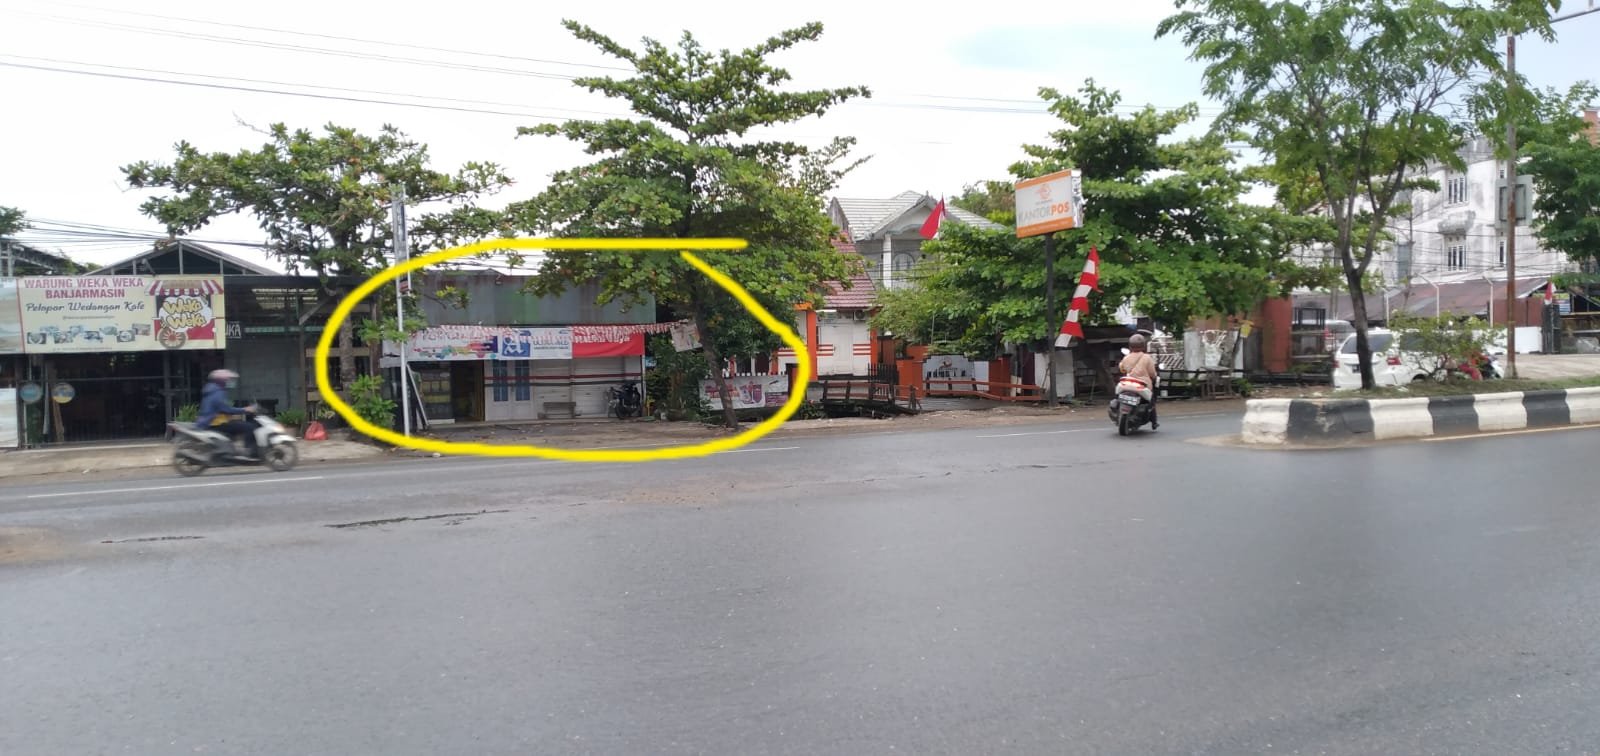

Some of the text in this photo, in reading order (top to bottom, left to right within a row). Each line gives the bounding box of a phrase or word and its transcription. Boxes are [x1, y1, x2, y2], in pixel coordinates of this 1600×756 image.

[24, 278, 73, 288] WARUNG
[76, 278, 109, 288] WEKA
[112, 277, 144, 288] WEKA
[45, 289, 125, 299] BANJARMASIN
[67, 302, 121, 313] Wedangan
